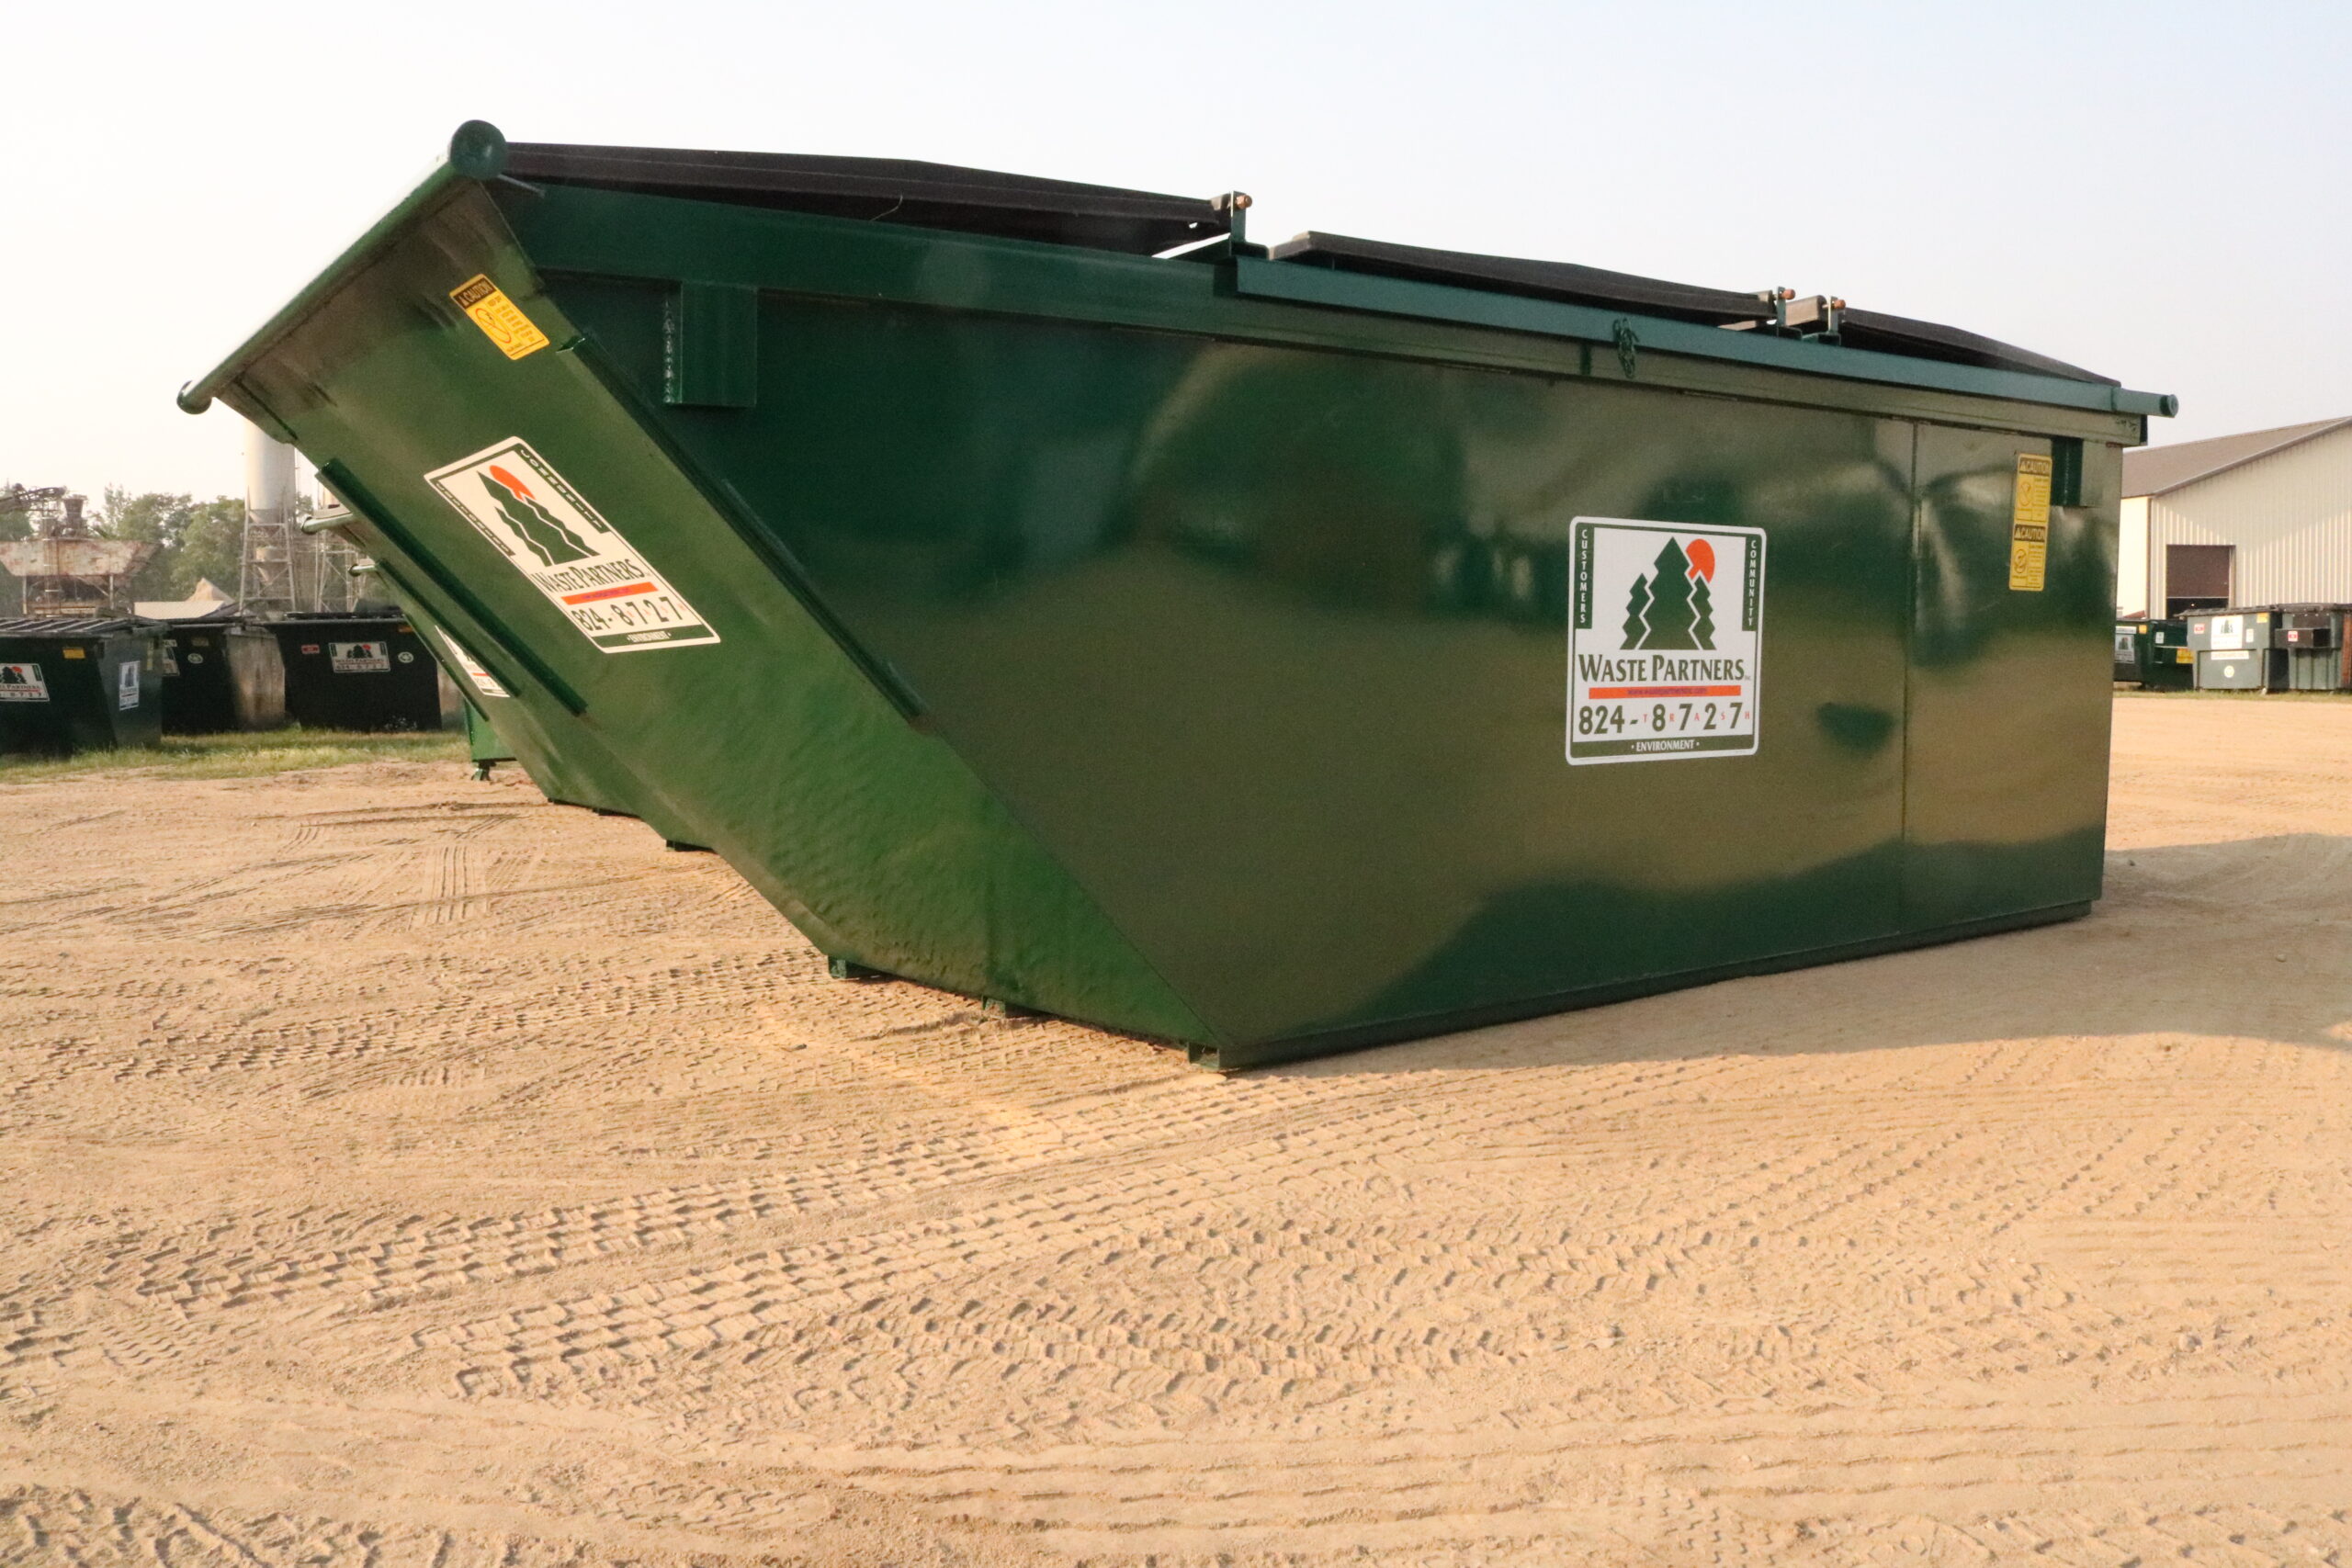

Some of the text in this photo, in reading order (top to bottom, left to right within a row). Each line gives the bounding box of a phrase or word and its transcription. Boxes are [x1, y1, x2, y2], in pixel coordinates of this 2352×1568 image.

[2026, 460, 2050, 475] CAUTION
[520, 449, 602, 528] COMMUNITY
[2020, 527, 2045, 540] CAUTION
[532, 558, 645, 593] WASTE PARTNERS
[1579, 528, 1589, 624] CUSTOMERS
[1748, 539, 1758, 626] COMMUNITY
[1578, 653, 1745, 682] WASTE PARTNERS
[1636, 739, 1694, 752] ENVIRONMENT
